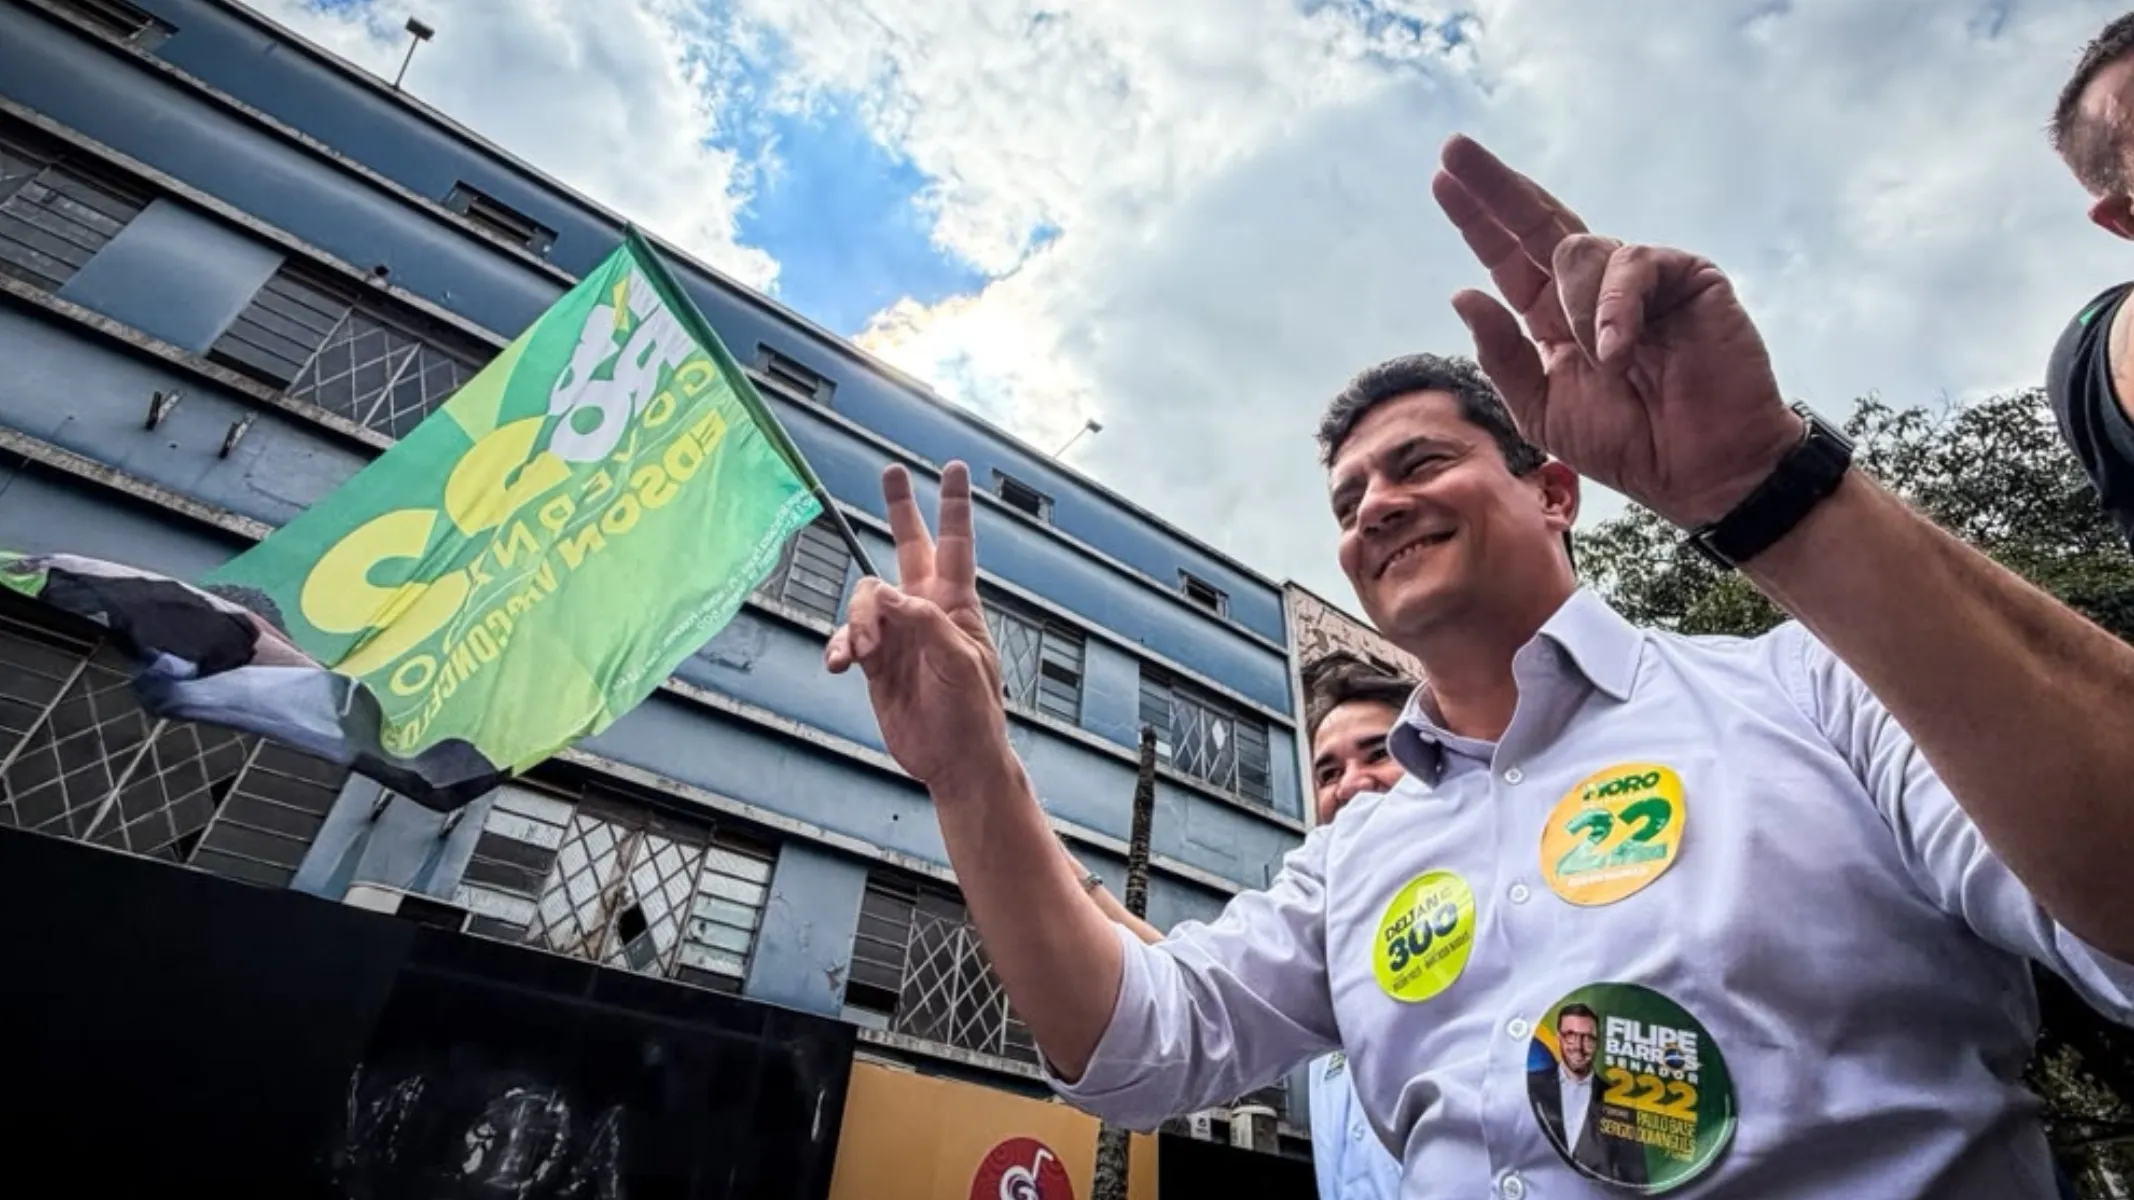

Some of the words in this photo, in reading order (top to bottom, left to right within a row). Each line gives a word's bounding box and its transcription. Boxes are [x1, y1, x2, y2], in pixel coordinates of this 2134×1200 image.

[1556, 797, 1672, 875] 22
[1388, 902, 1459, 973] 300
[1606, 1015, 1698, 1053] FILIPE
[1606, 1038, 1700, 1071] BARROS
[1605, 1055, 1698, 1085] SENADOR
[1603, 1066, 1697, 1123] 222
